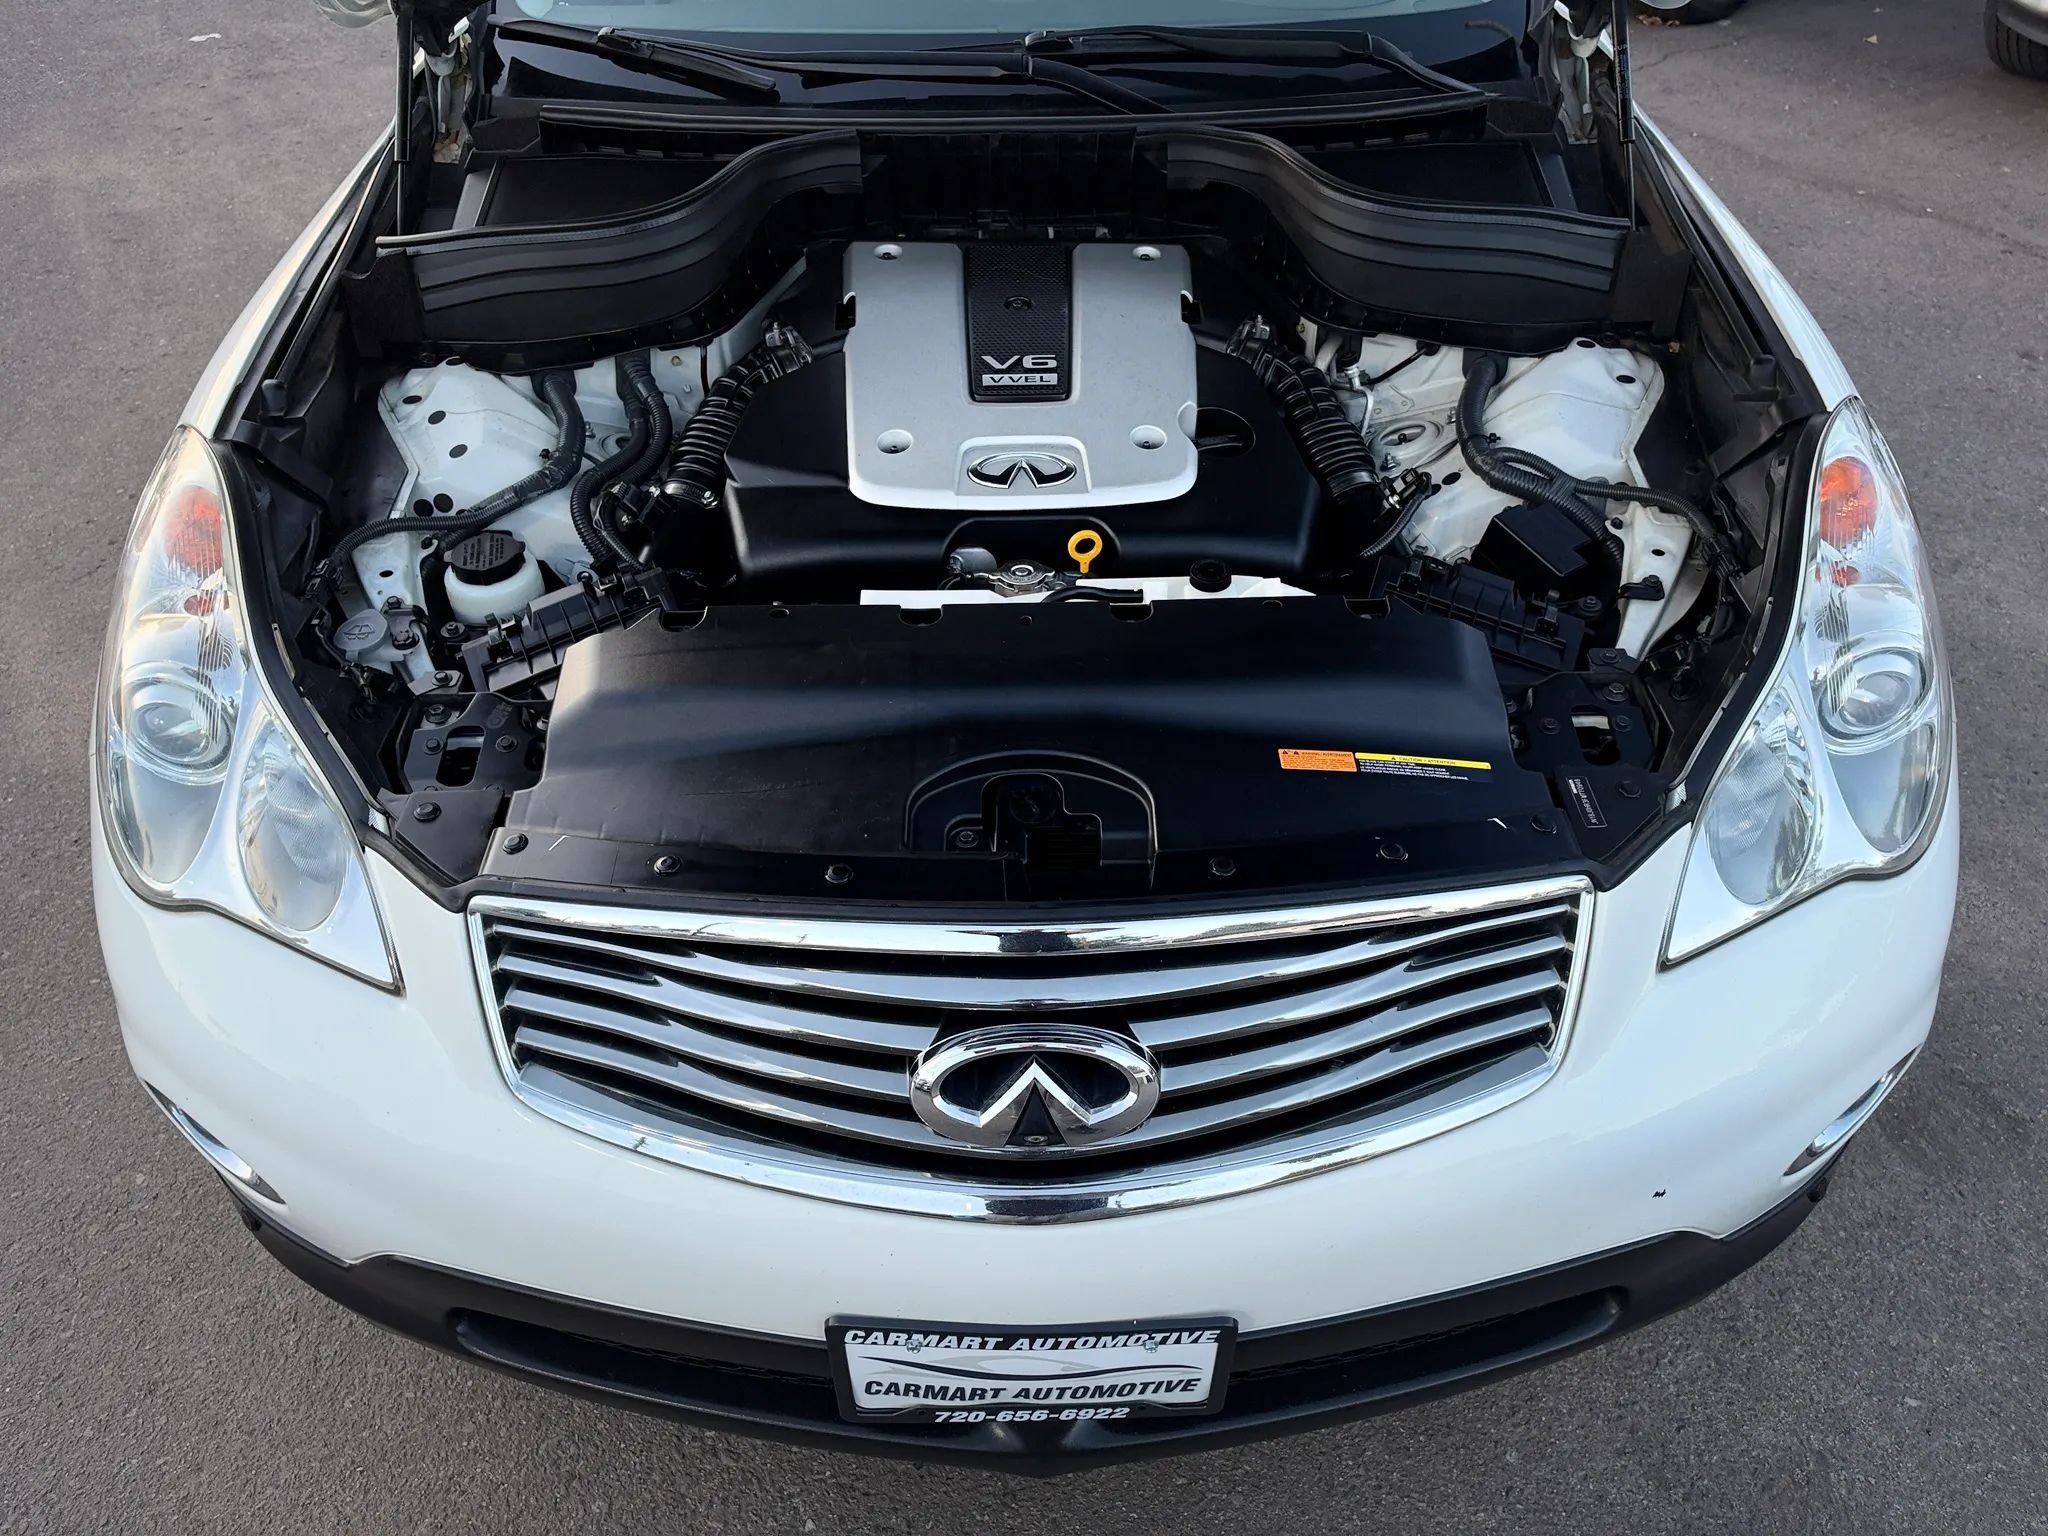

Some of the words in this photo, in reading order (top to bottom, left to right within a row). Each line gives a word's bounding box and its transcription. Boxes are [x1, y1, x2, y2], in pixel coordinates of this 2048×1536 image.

[981, 354, 1058, 370] V6
[989, 375, 1052, 383] VVEL
[844, 1329, 1004, 1350] CARMART
[1008, 1329, 1221, 1351] AUTOMOTIVE
[864, 1380, 1007, 1402] CARMART
[1011, 1377, 1203, 1401] AUTOMOTIVE
[934, 1407, 1131, 1424] 720-656-6922
